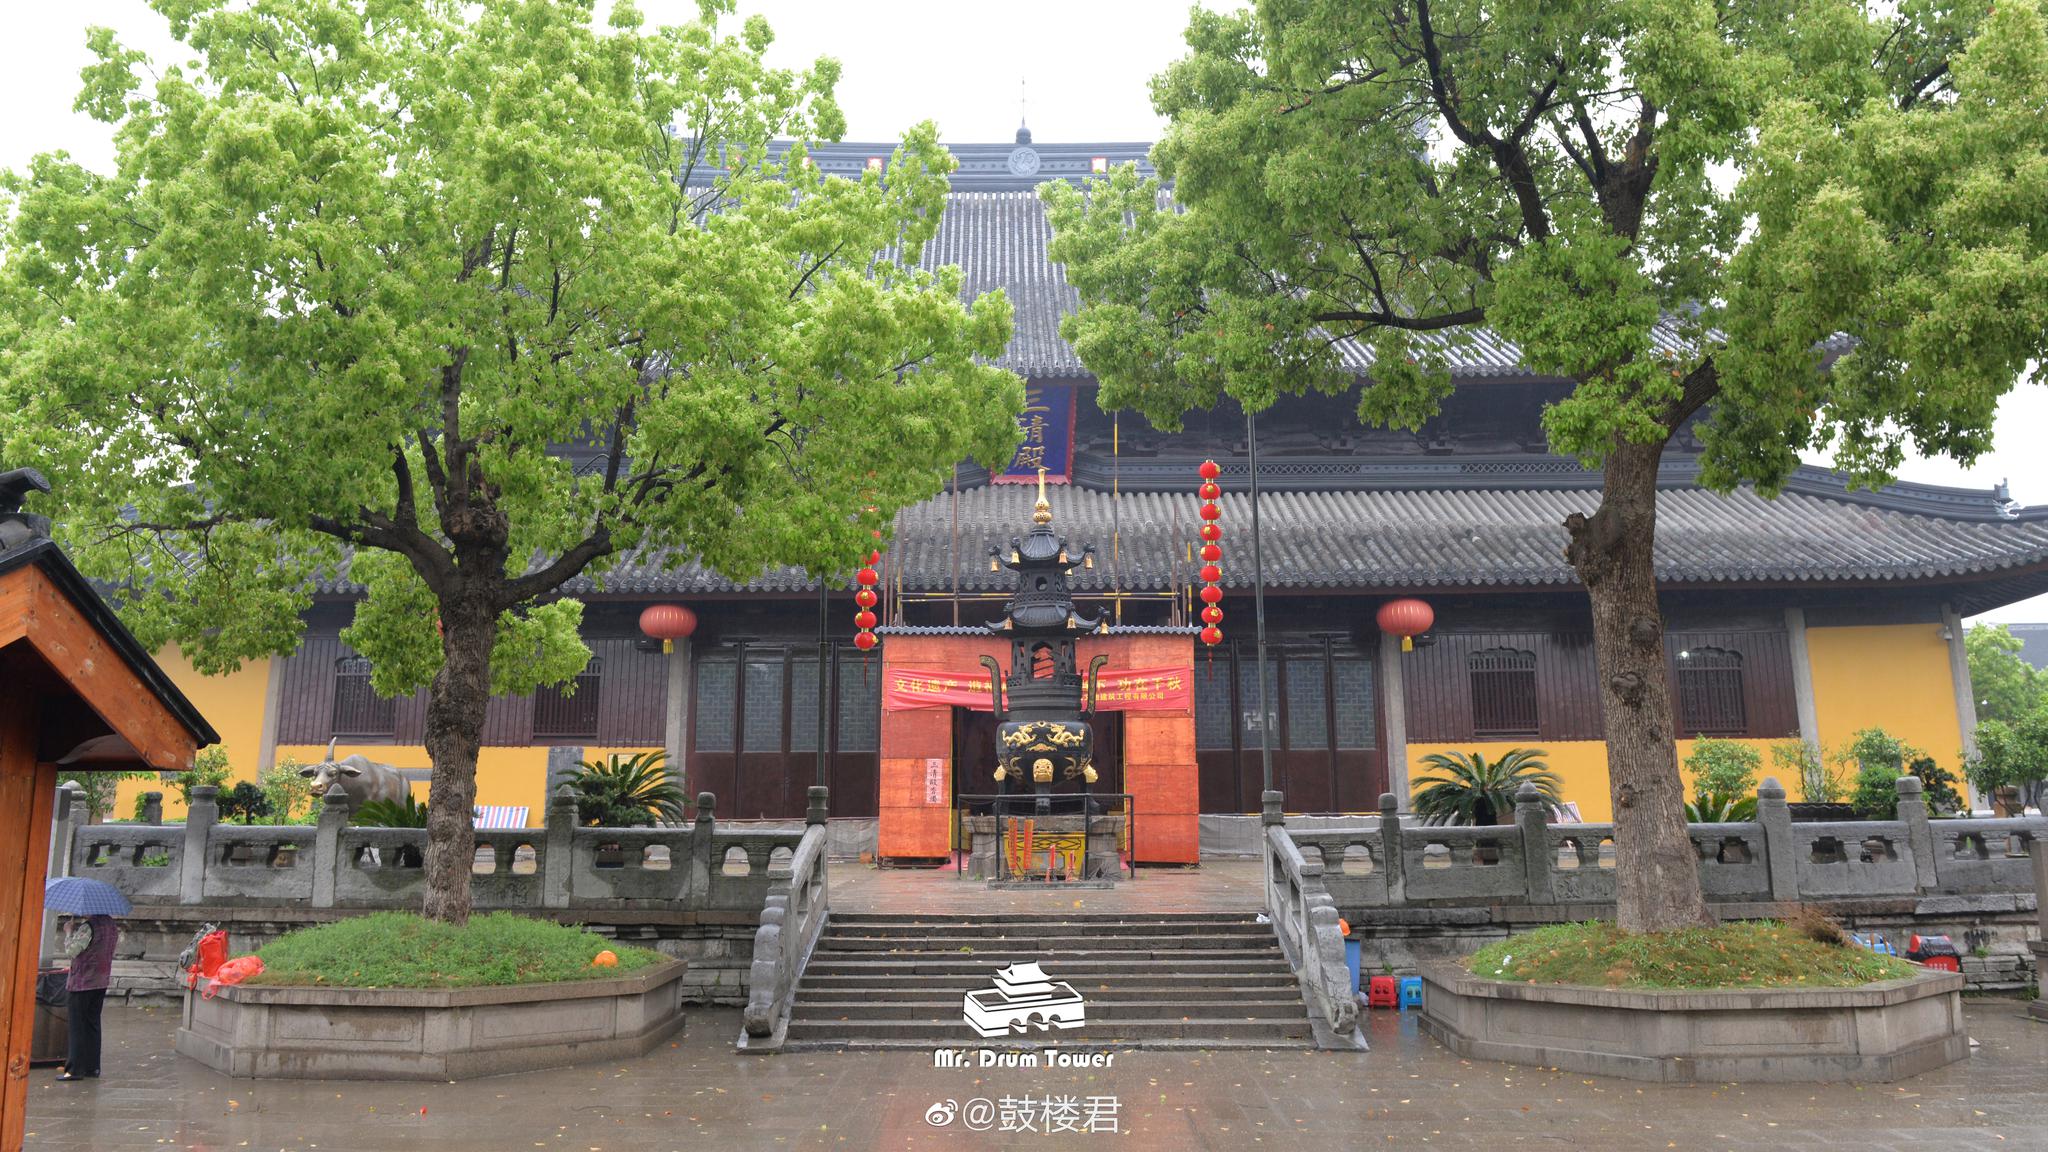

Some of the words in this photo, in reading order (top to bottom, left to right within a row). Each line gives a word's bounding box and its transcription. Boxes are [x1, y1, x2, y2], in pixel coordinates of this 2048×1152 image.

[1014, 389, 1051, 471] 三清殿
[894, 679, 958, 693] 文化遗产
[1118, 675, 1182, 691] 功在千秋
